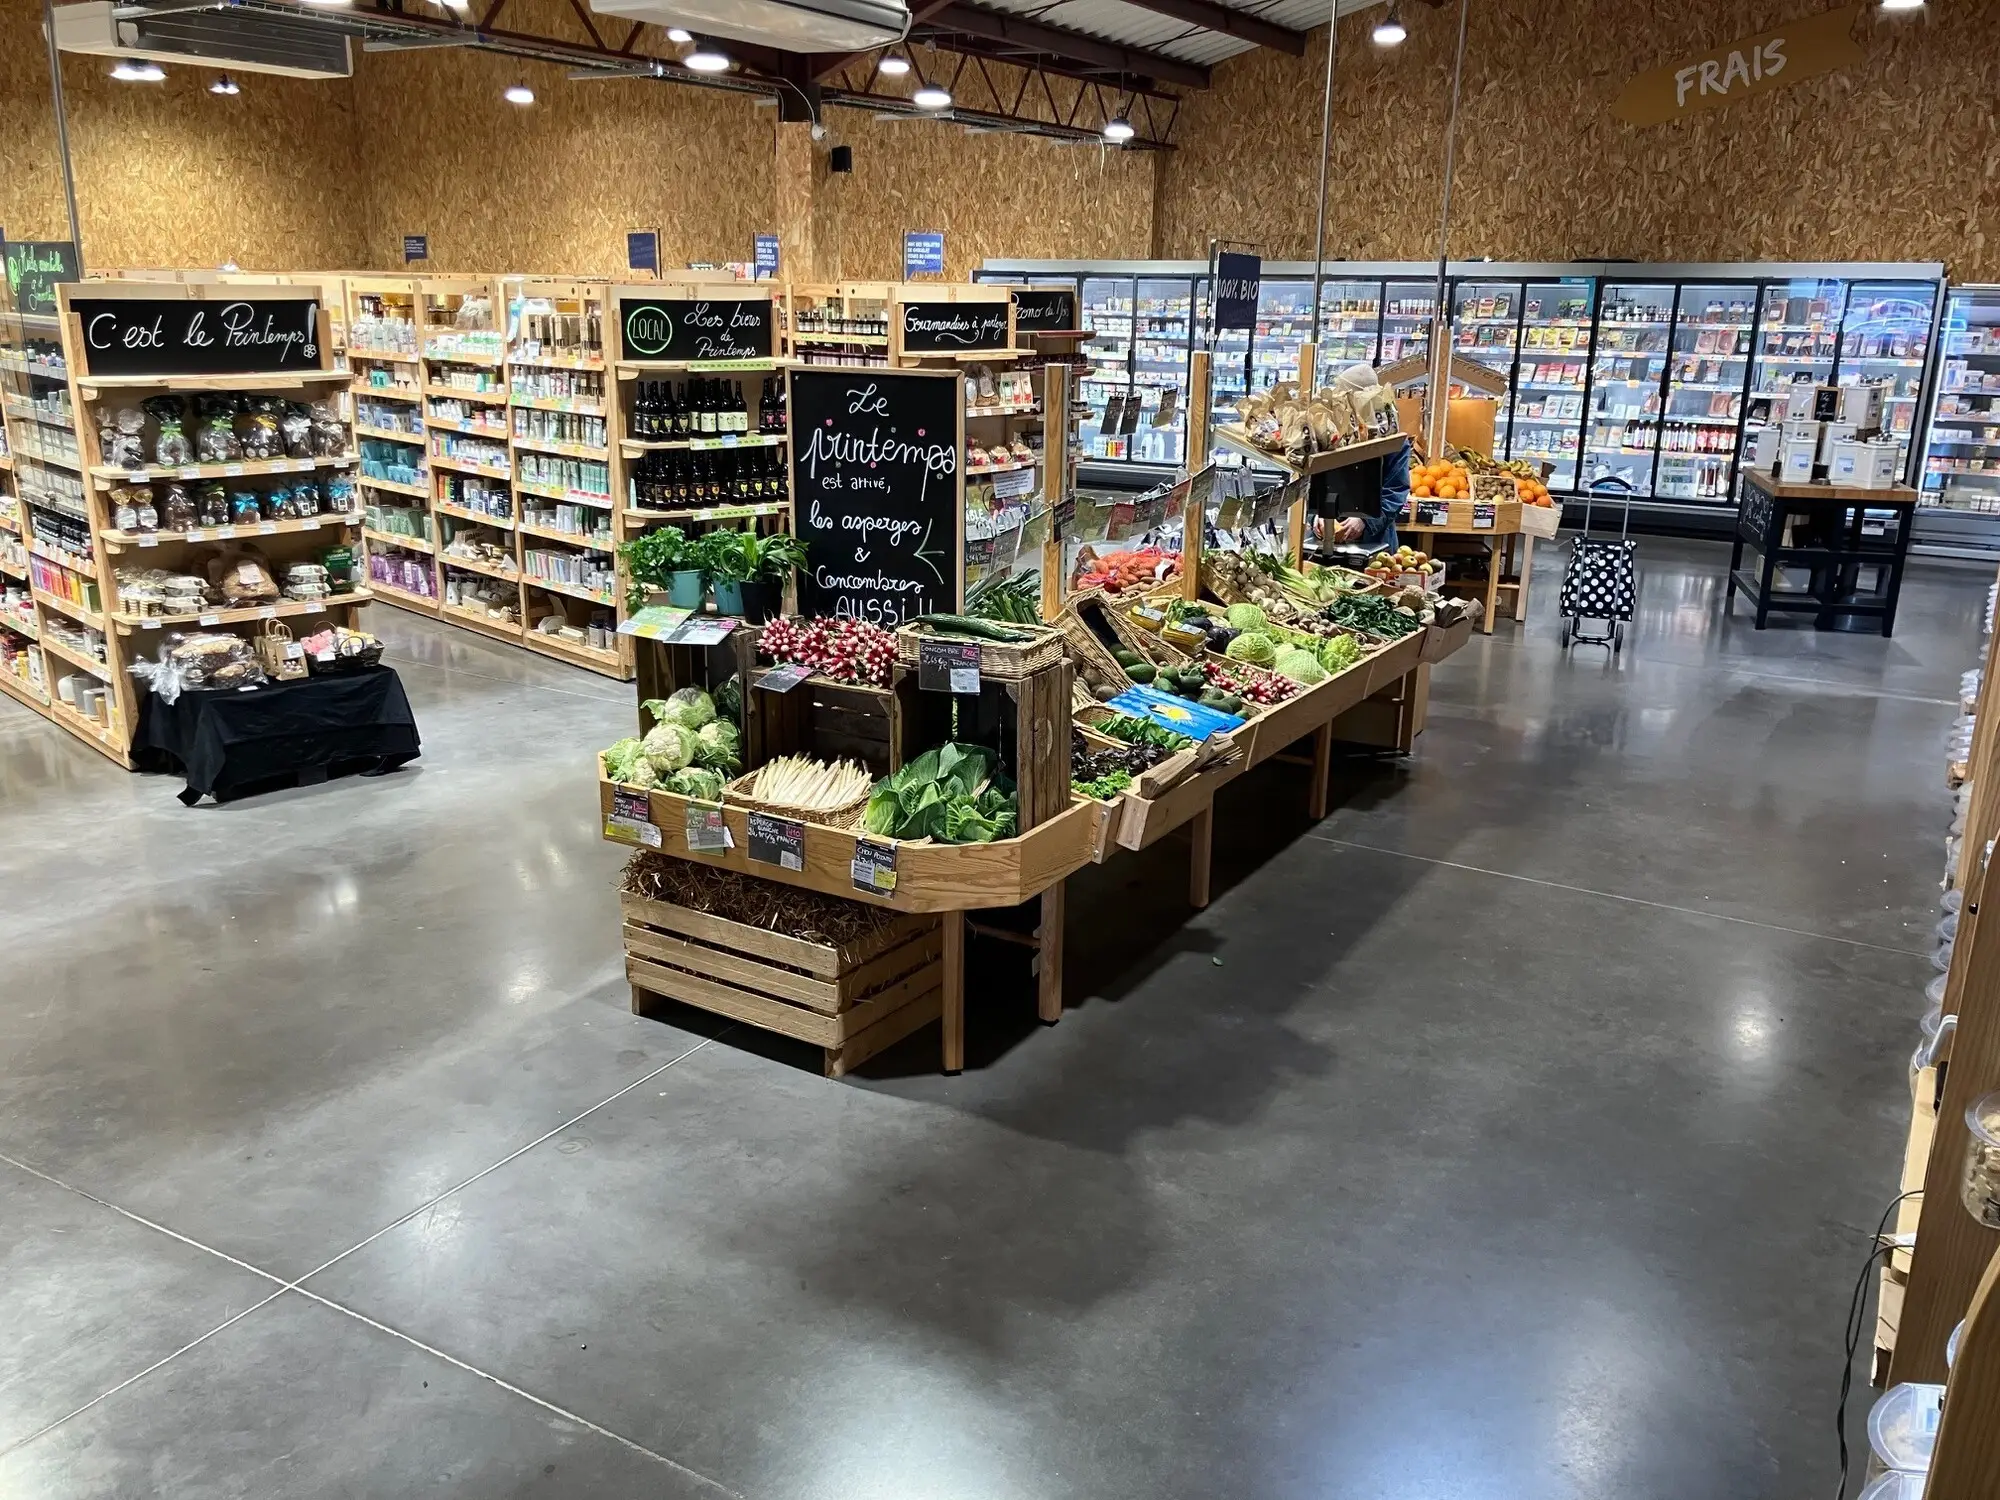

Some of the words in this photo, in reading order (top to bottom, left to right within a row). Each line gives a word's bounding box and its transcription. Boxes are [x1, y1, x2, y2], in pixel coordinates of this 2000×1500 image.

[1674, 38, 1788, 107] FRAIS
[1218, 278, 1238, 300] 100%
[1240, 280, 1259, 301] BIO
[683, 302, 724, 328] Les
[1044, 300, 1055, 317] du
[89, 312, 164, 350] C'est
[183, 311, 215, 347] le
[632, 318, 668, 342] LOCAL
[720, 327, 735, 342] de
[904, 306, 970, 333] Gourmandises
[971, 316, 979, 329] à
[981, 313, 1008, 341] partager
[695, 336, 757, 360] Printemps
[845, 383, 890, 417] Le
[800, 426, 957, 502] printemps
[821, 472, 843, 490] est
[850, 477, 892, 495] arrivé,
[808, 499, 834, 530] les
[841, 513, 922, 547] asperges
[854, 546, 872, 563] &
[815, 564, 925, 594] Concombres
[856, 846, 873, 856] CHOU
